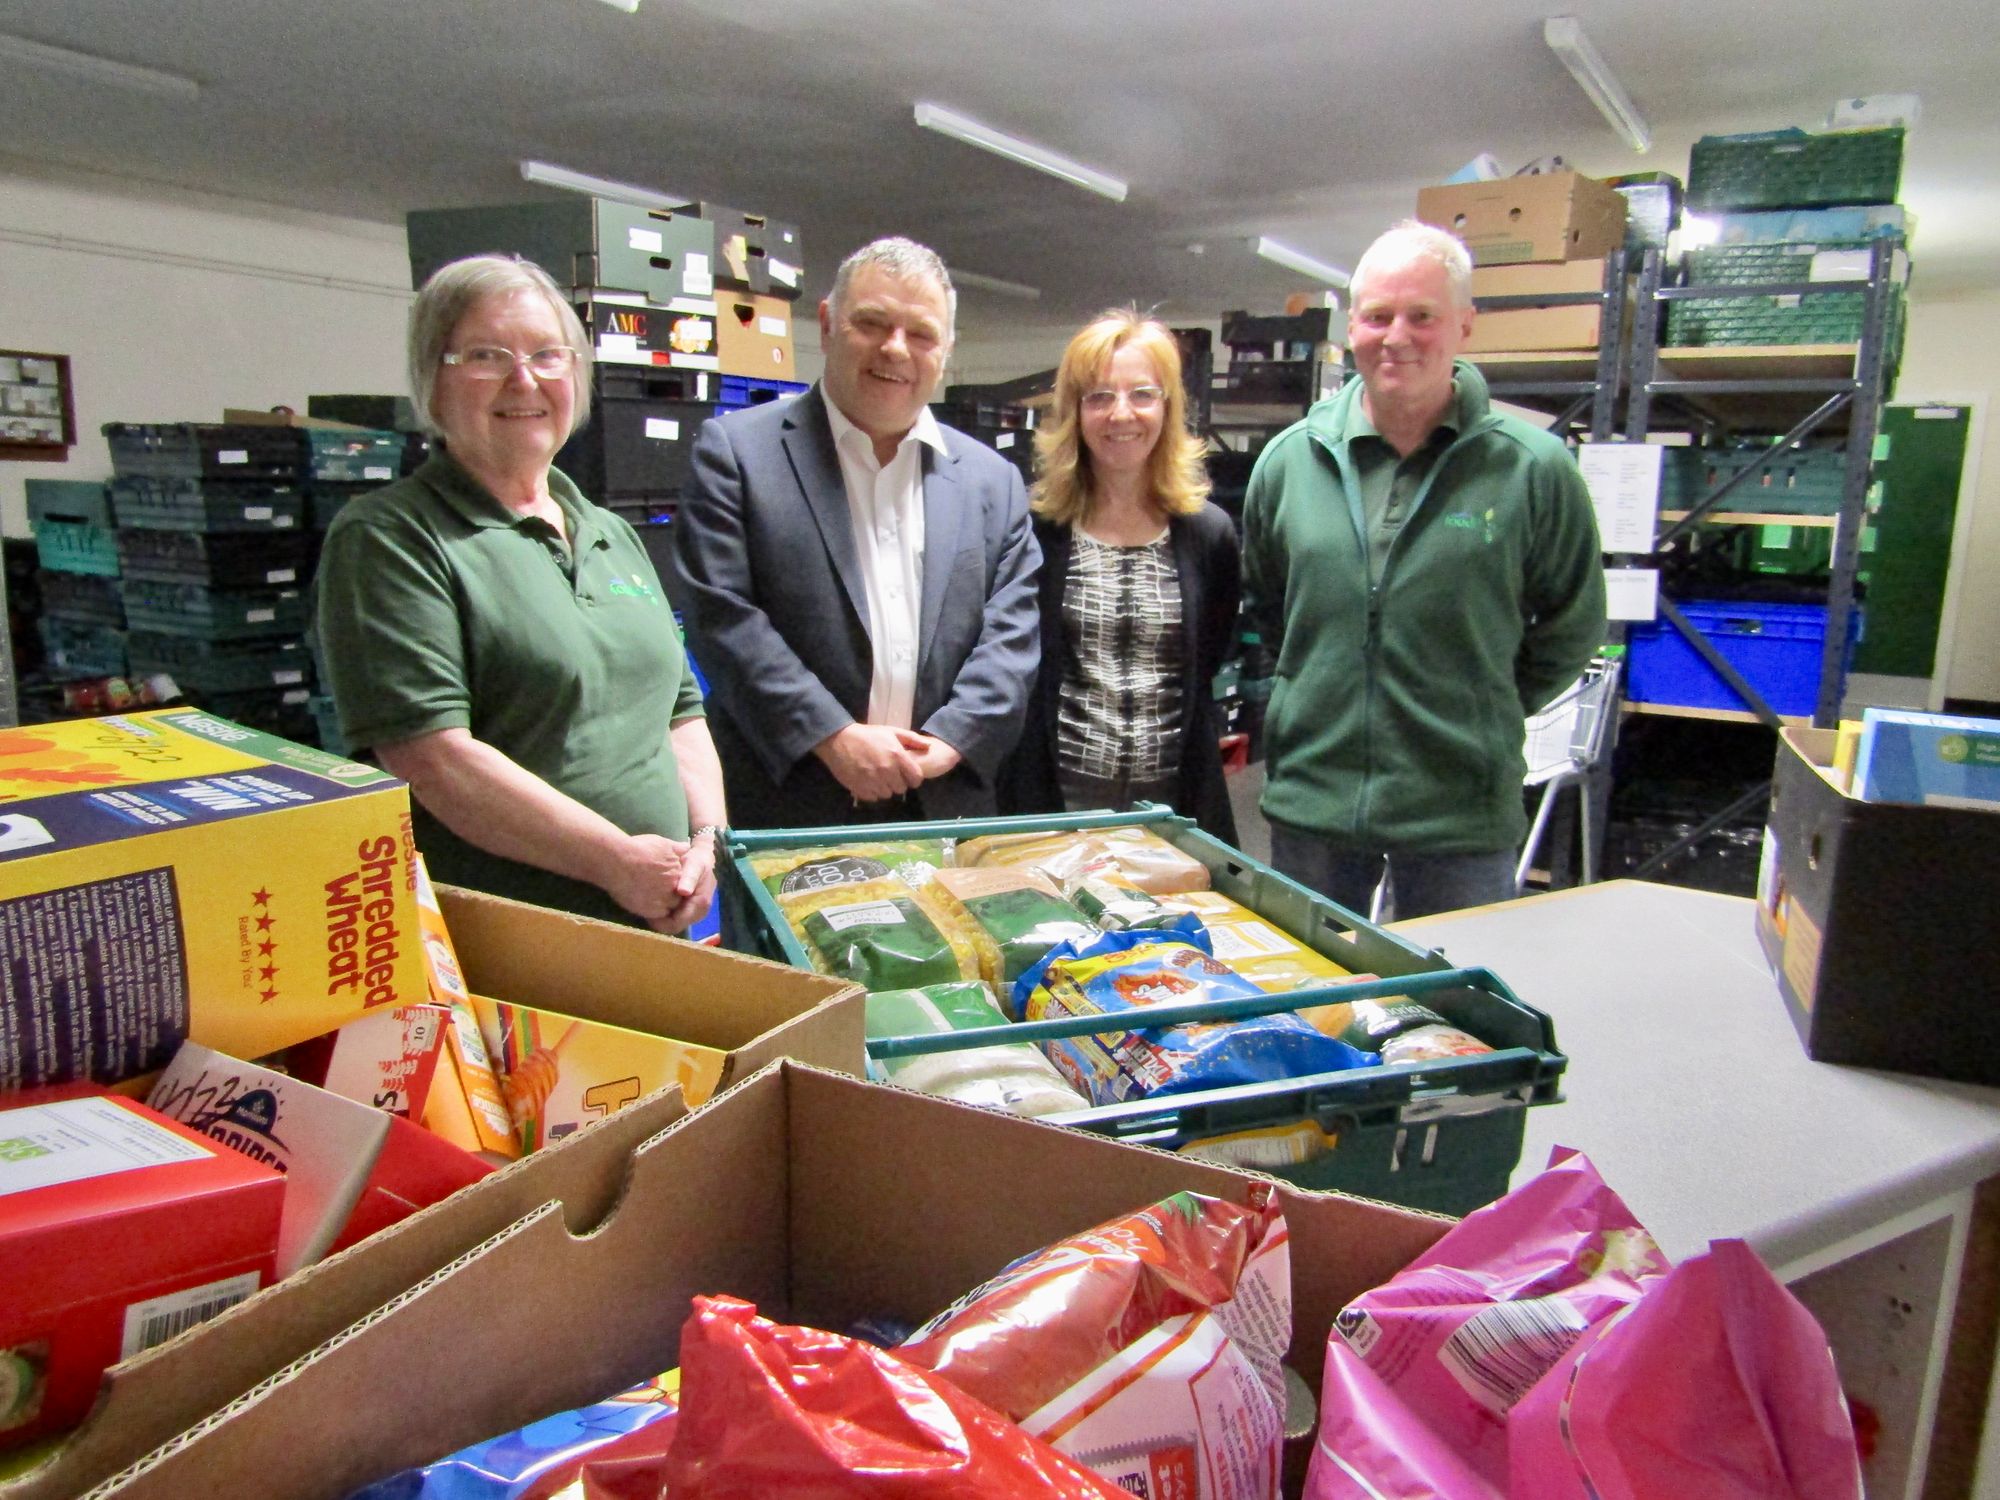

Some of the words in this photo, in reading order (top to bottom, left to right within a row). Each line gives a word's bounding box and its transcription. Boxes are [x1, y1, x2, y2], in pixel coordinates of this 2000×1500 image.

[606, 312, 648, 336] AMC
[280, 790, 315, 801] UP
[163, 906, 172, 919] UP
[358, 836, 399, 1009] Shredded
[238, 914, 250, 947] Rated
[325, 872, 358, 997] Wheat
[239, 948, 251, 964] By
[414, 1026, 425, 1041] 10
